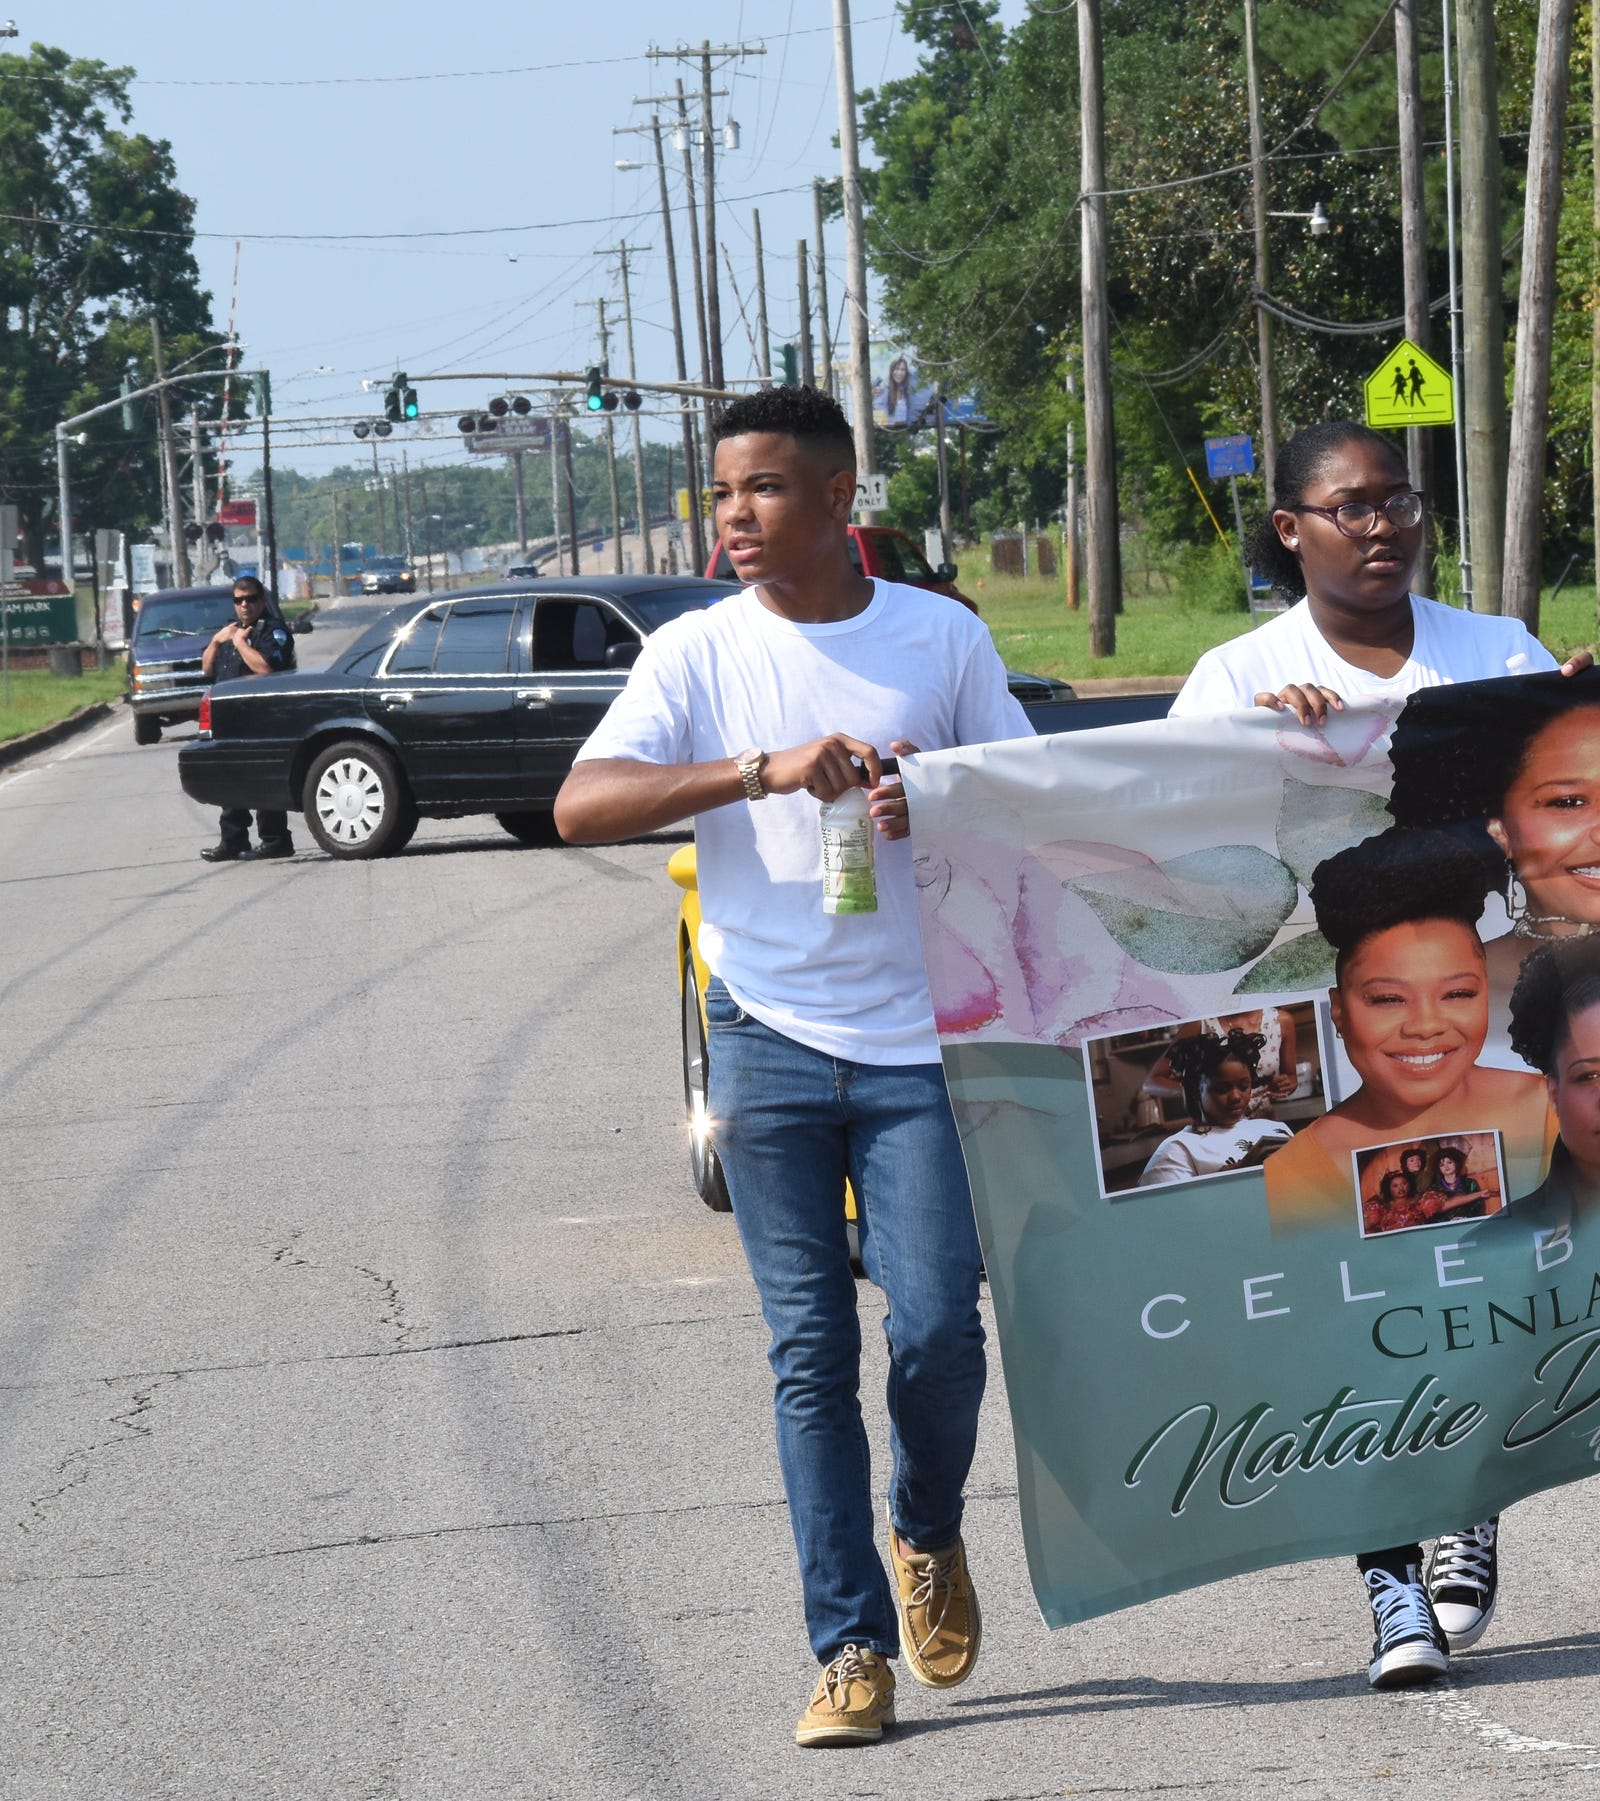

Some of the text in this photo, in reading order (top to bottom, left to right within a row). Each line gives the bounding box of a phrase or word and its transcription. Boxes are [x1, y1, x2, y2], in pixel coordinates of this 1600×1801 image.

[857, 497, 882, 507] ONLY
[24, 602, 50, 613] PARK
[821, 827, 831, 896] BODYARMOR
[1124, 1374, 1489, 1517] Natalie
